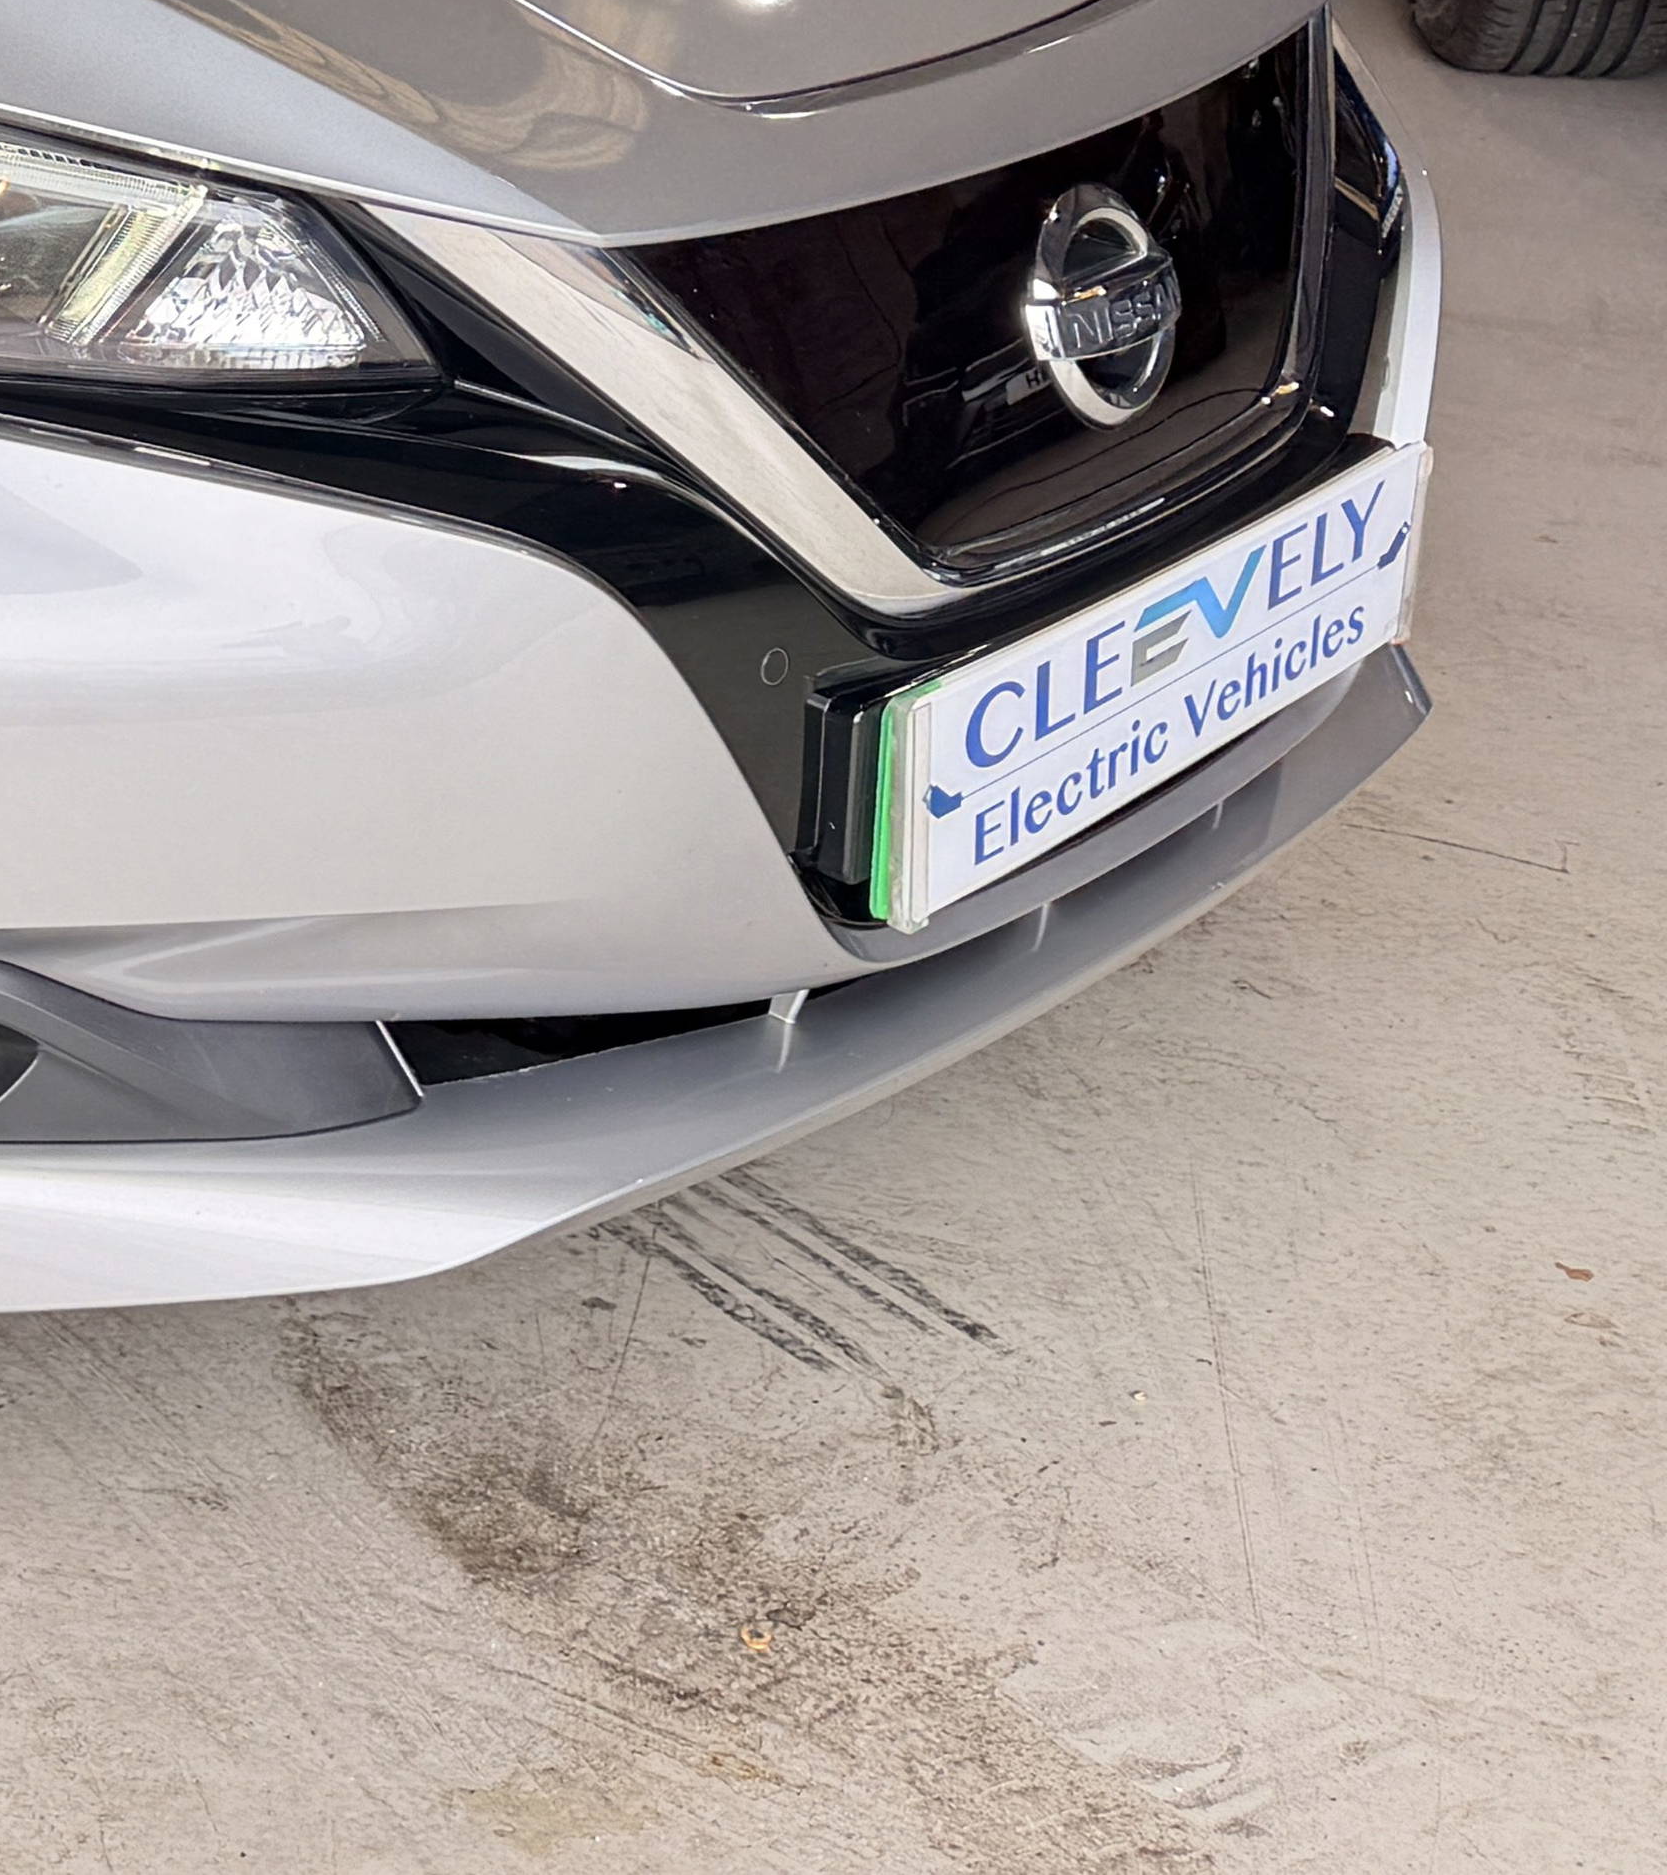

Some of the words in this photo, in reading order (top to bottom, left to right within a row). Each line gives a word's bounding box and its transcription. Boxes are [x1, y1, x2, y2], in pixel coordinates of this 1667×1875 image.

[964, 481, 1386, 770] CLEEVELY
[973, 717, 1170, 867] Electric
[1184, 605, 1365, 743] Vehicles
